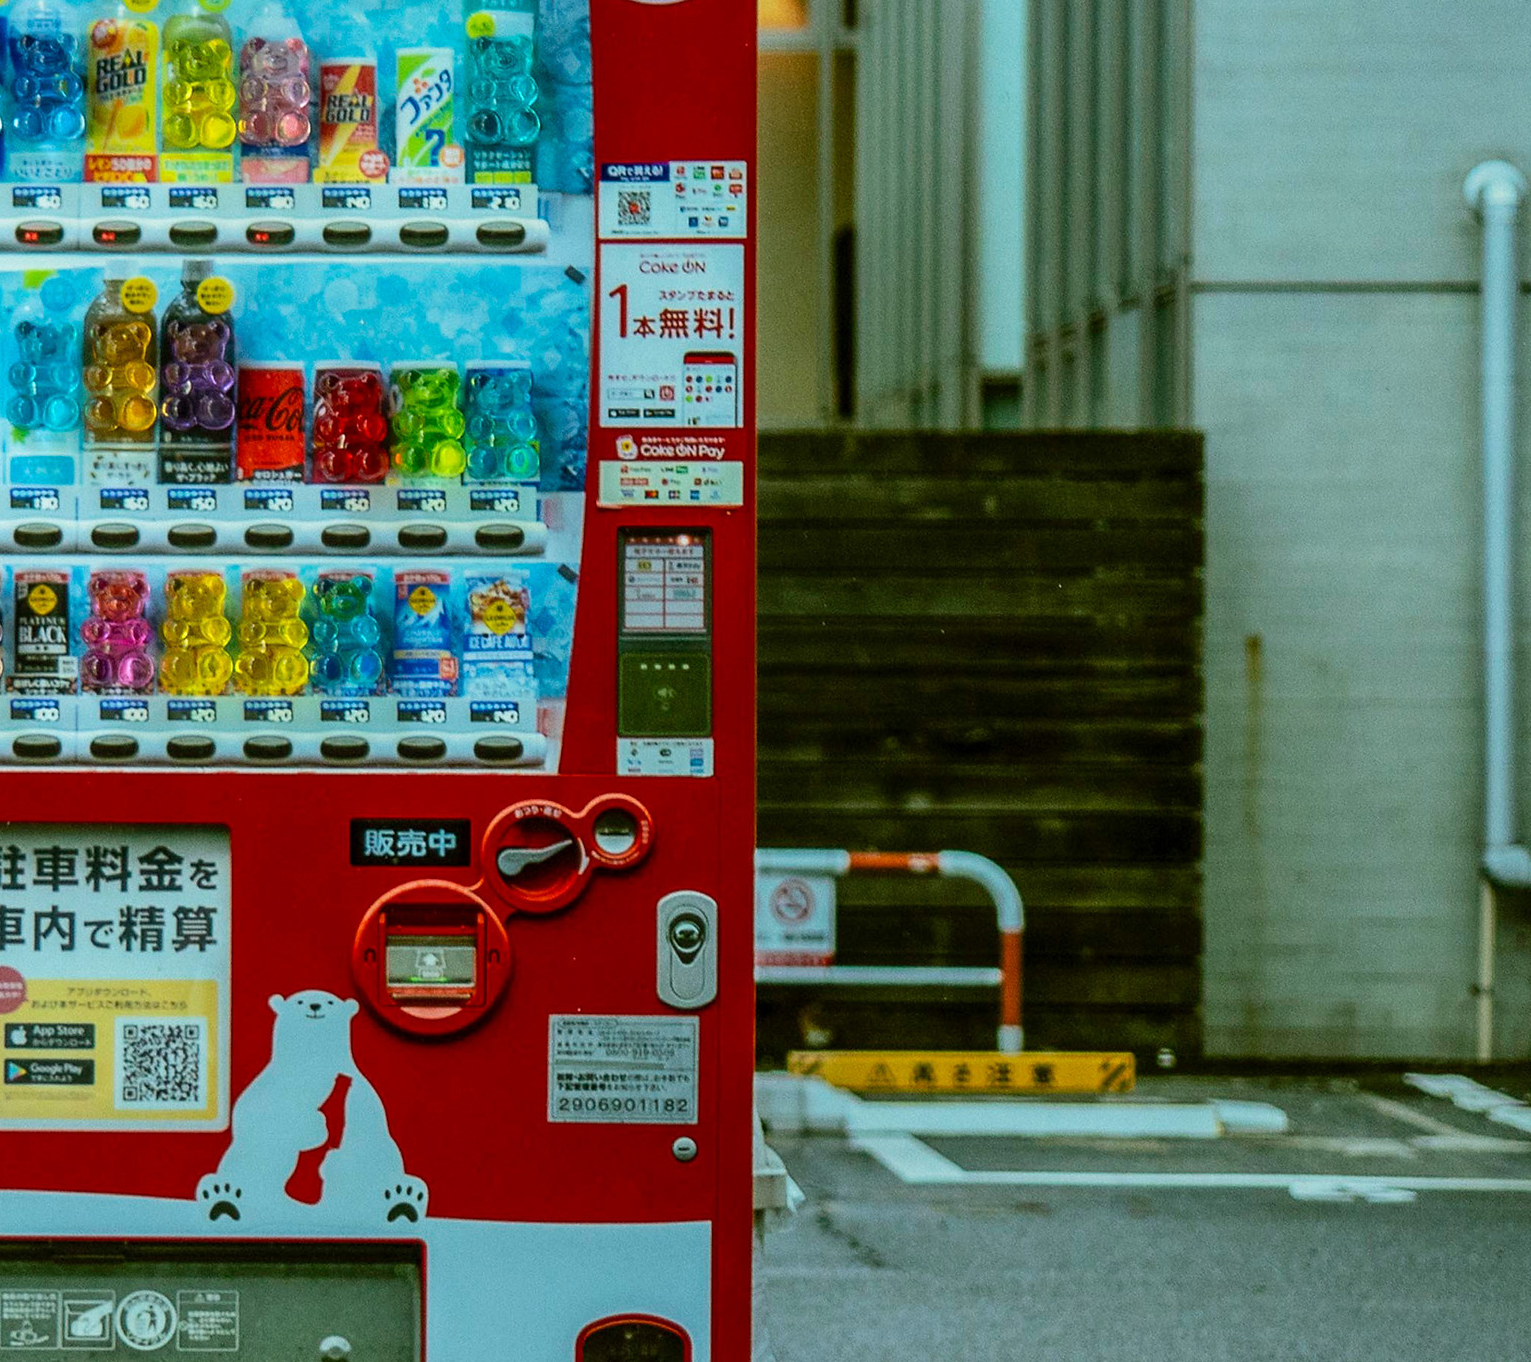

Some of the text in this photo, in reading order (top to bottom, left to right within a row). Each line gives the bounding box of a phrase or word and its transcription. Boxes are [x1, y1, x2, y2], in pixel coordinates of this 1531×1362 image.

[326, 92, 371, 109] REAL
[325, 107, 370, 124] GOLD
[639, 260, 678, 274] Coke
[608, 283, 735, 339] 1本無料!
[640, 443, 675, 457] Coke
[698, 443, 726, 461] Pay
[18, 626, 67, 644] BLACK
[363, 827, 458, 858] 販売中
[32, 1025, 86, 1038] App Store
[30, 1064, 84, 1077] Google Play
[558, 1097, 689, 1113] 2906901182
